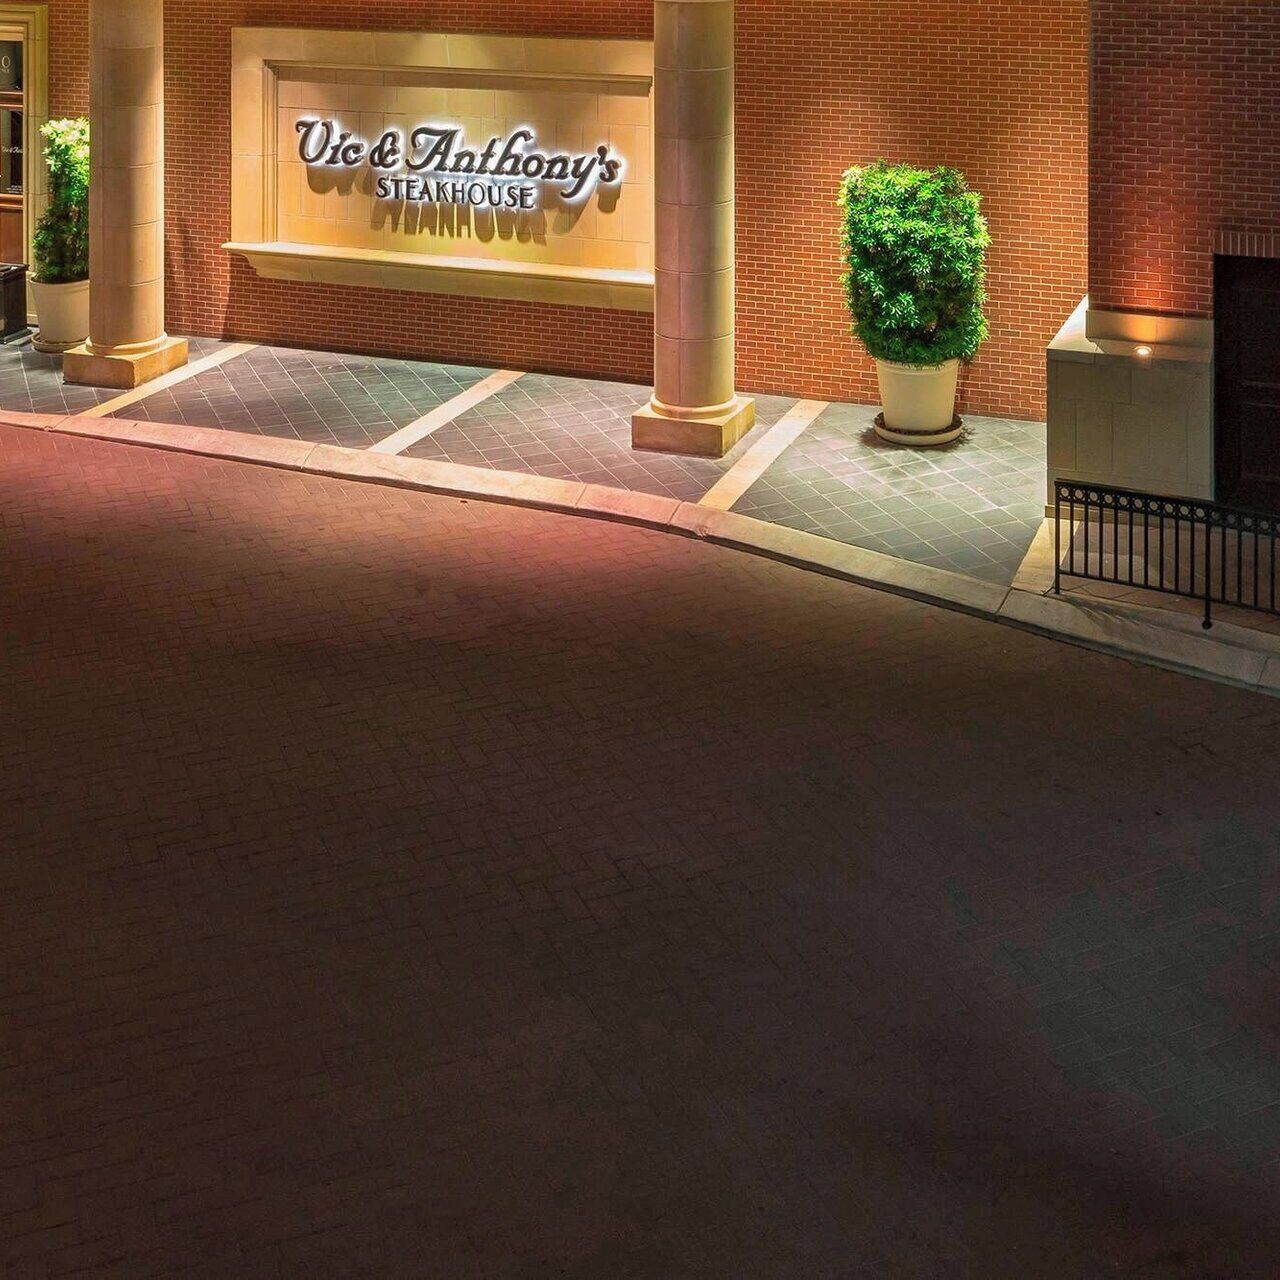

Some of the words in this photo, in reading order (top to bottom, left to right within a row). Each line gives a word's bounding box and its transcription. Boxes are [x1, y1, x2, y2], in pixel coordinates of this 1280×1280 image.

[295, 120, 364, 166] Vic
[369, 131, 400, 168] &
[405, 126, 622, 198] Anthony's
[376, 177, 536, 209] STEAKHOUSE
